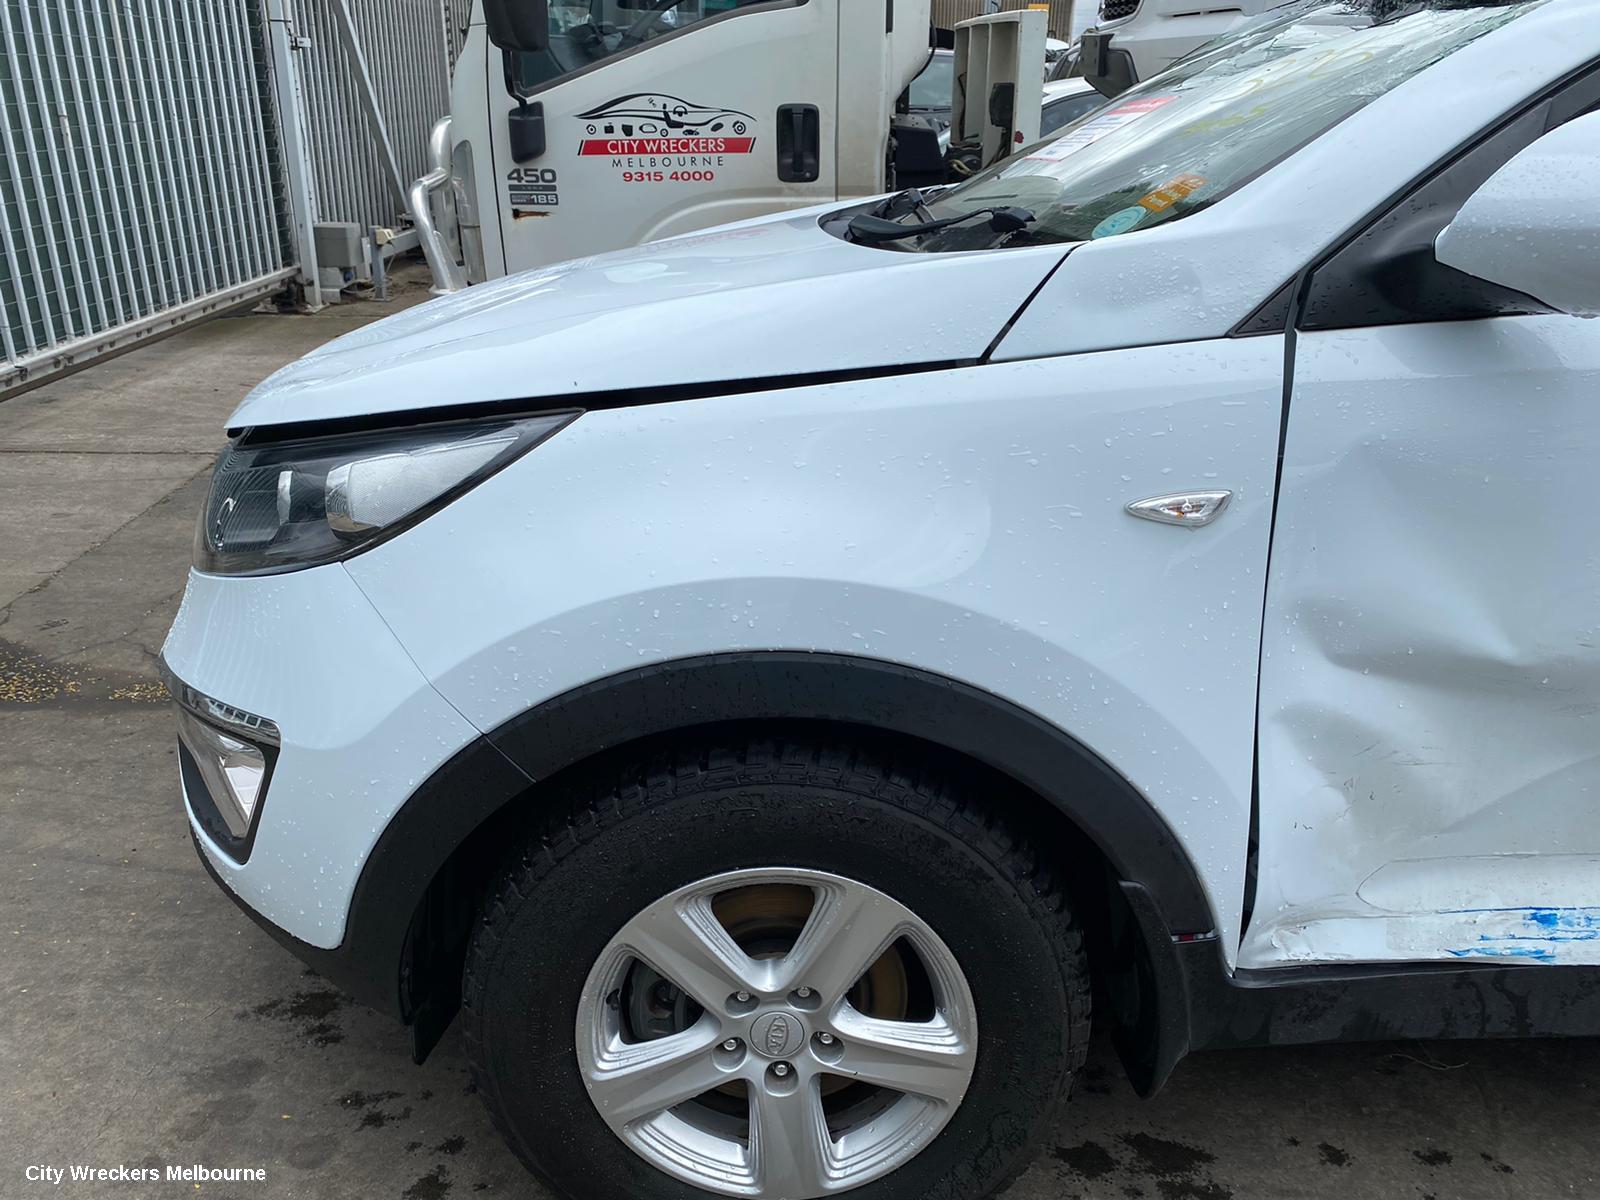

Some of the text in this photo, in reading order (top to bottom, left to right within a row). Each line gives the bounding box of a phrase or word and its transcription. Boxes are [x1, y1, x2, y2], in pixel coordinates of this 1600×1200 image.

[607, 138, 726, 154] CITY WRECKERS
[612, 156, 724, 168] MELBOURNE
[507, 168, 557, 183] 450
[622, 171, 714, 182] 9315 4000
[768, 1022, 785, 1048] KIA
